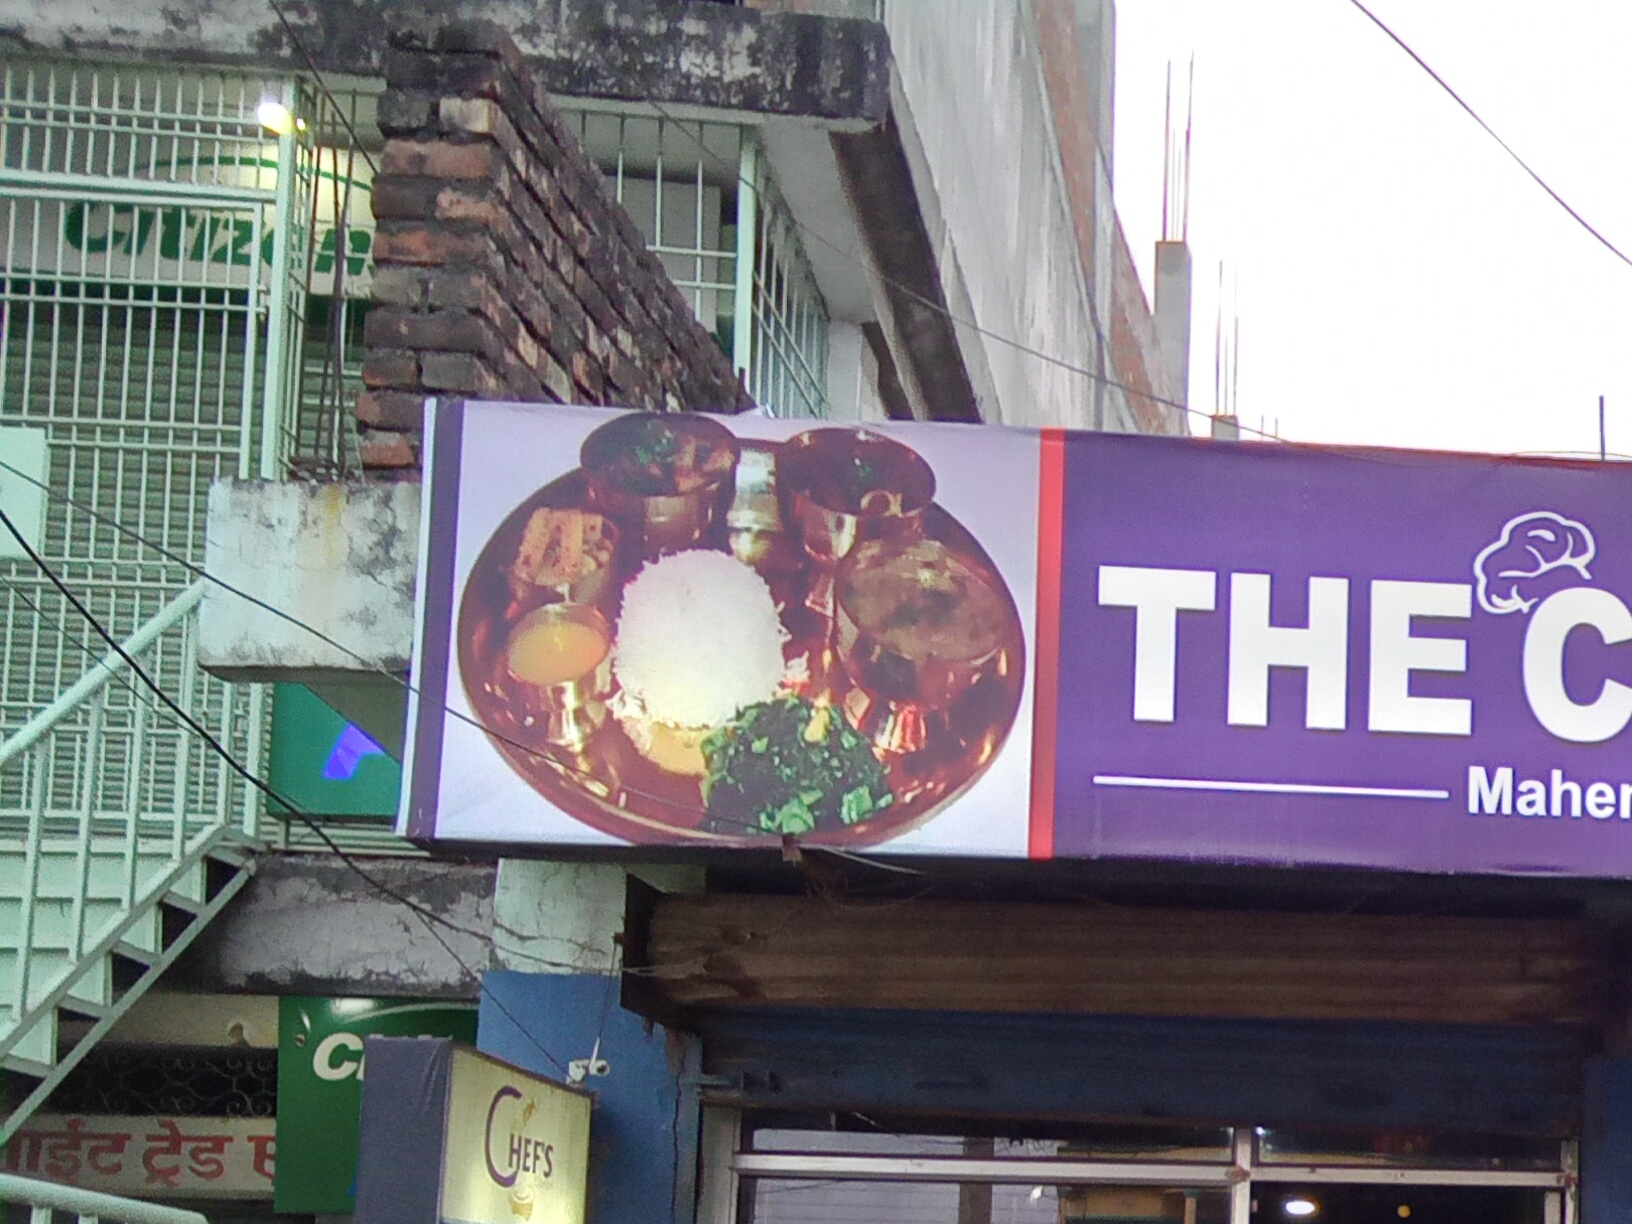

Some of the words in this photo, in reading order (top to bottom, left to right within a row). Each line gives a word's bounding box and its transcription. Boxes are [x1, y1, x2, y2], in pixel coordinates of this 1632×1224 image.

[65, 200, 374, 276] Citizn
[1098, 565, 1472, 735] THE
[142, 1119, 234, 1186] ट्रेड
[485, 1085, 554, 1188] CHEF'S
